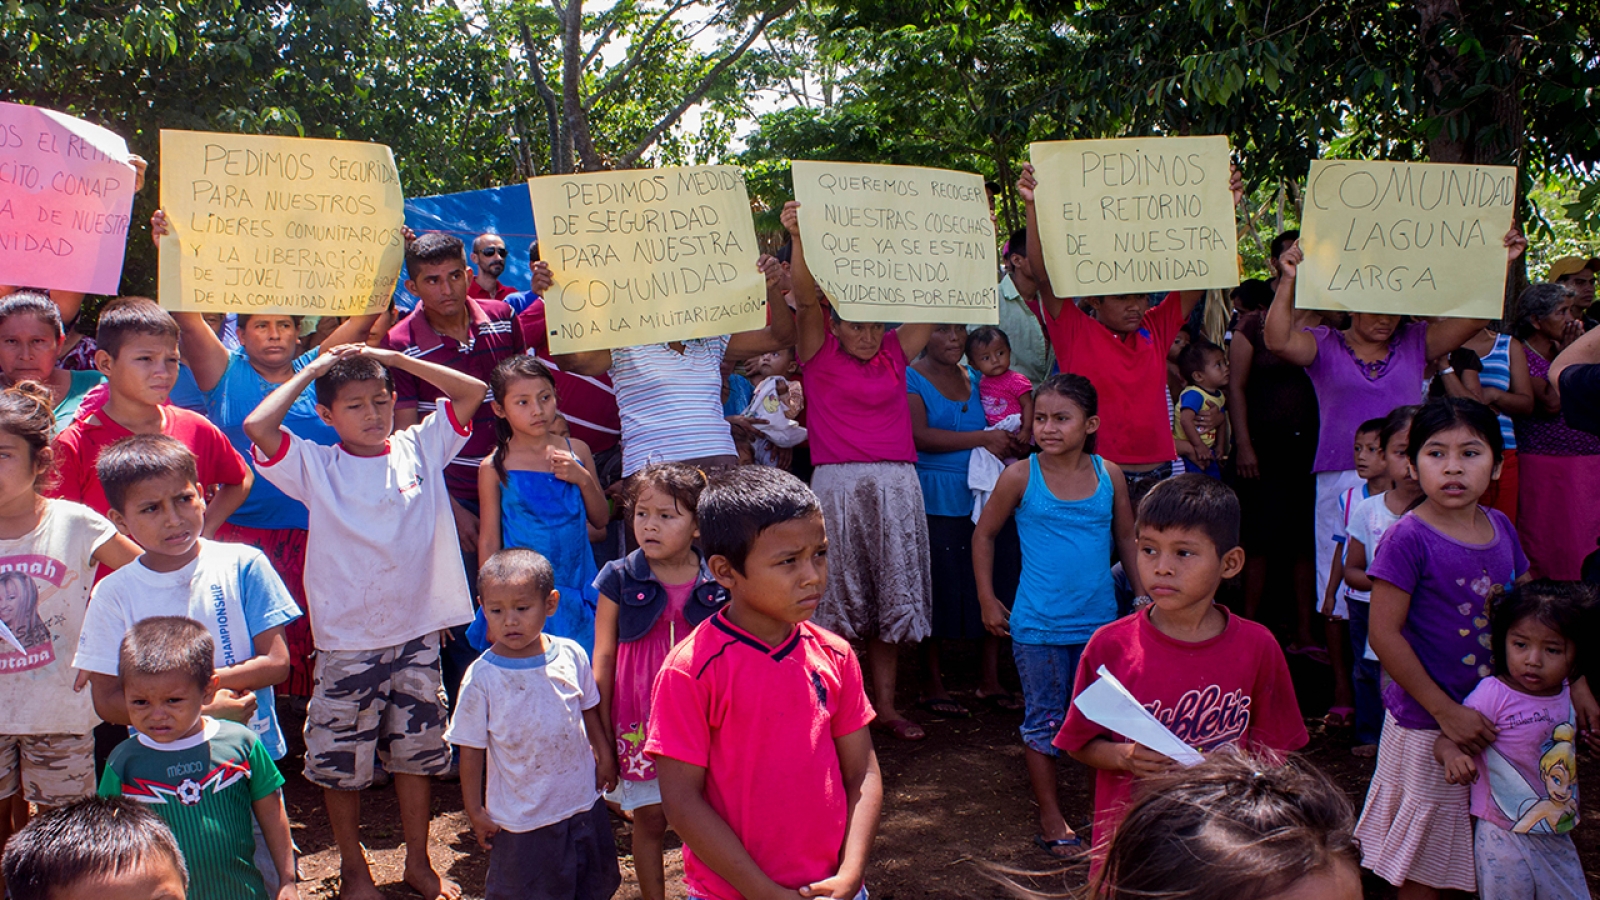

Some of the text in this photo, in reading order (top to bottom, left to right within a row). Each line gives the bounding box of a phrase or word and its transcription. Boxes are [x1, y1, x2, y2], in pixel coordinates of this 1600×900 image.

[37, 132, 58, 153] EL
[203, 144, 314, 181] PEDIMOS
[1081, 149, 1206, 188] PEDIMOS
[51, 170, 120, 198] CONAP
[191, 179, 376, 216] PARA NUESTROS
[561, 175, 669, 209] PEDIMOS
[818, 173, 985, 203] QUEREMOS RECOGER
[1312, 163, 1515, 212] COMUNIDAD
[37, 206, 62, 226] DE
[824, 203, 992, 237] NUESTRAS COSECHAS
[1063, 193, 1201, 221] EL RETORNO
[285, 221, 401, 247] COMUNITARIOS
[552, 214, 579, 236] DE
[1343, 217, 1486, 252] LAGUNA
[554, 230, 743, 271] PARA NUESTRA
[821, 232, 861, 256] QUE
[929, 239, 986, 260] ESTAN
[1066, 225, 1228, 256] DE NUESTRA
[189, 243, 375, 273] Y LA LIBERACIÓN
[834, 257, 950, 283] PERDIENDO.
[1075, 257, 1210, 284] COMUNIDAD
[193, 266, 213, 282] DE
[224, 267, 284, 290] JOVEL
[292, 269, 346, 290] TOVAR
[560, 262, 738, 312] COMUNIDAD
[1327, 264, 1437, 292] LARGA
[193, 289, 215, 304] DE
[223, 291, 243, 306] LA
[246, 293, 326, 309] COMUNIDAD
[330, 295, 346, 311] LA
[912, 288, 945, 305] POR
[590, 320, 601, 334] A
[609, 317, 631, 332] LA
[210, 583, 236, 667] CHAMPIONSHIP
